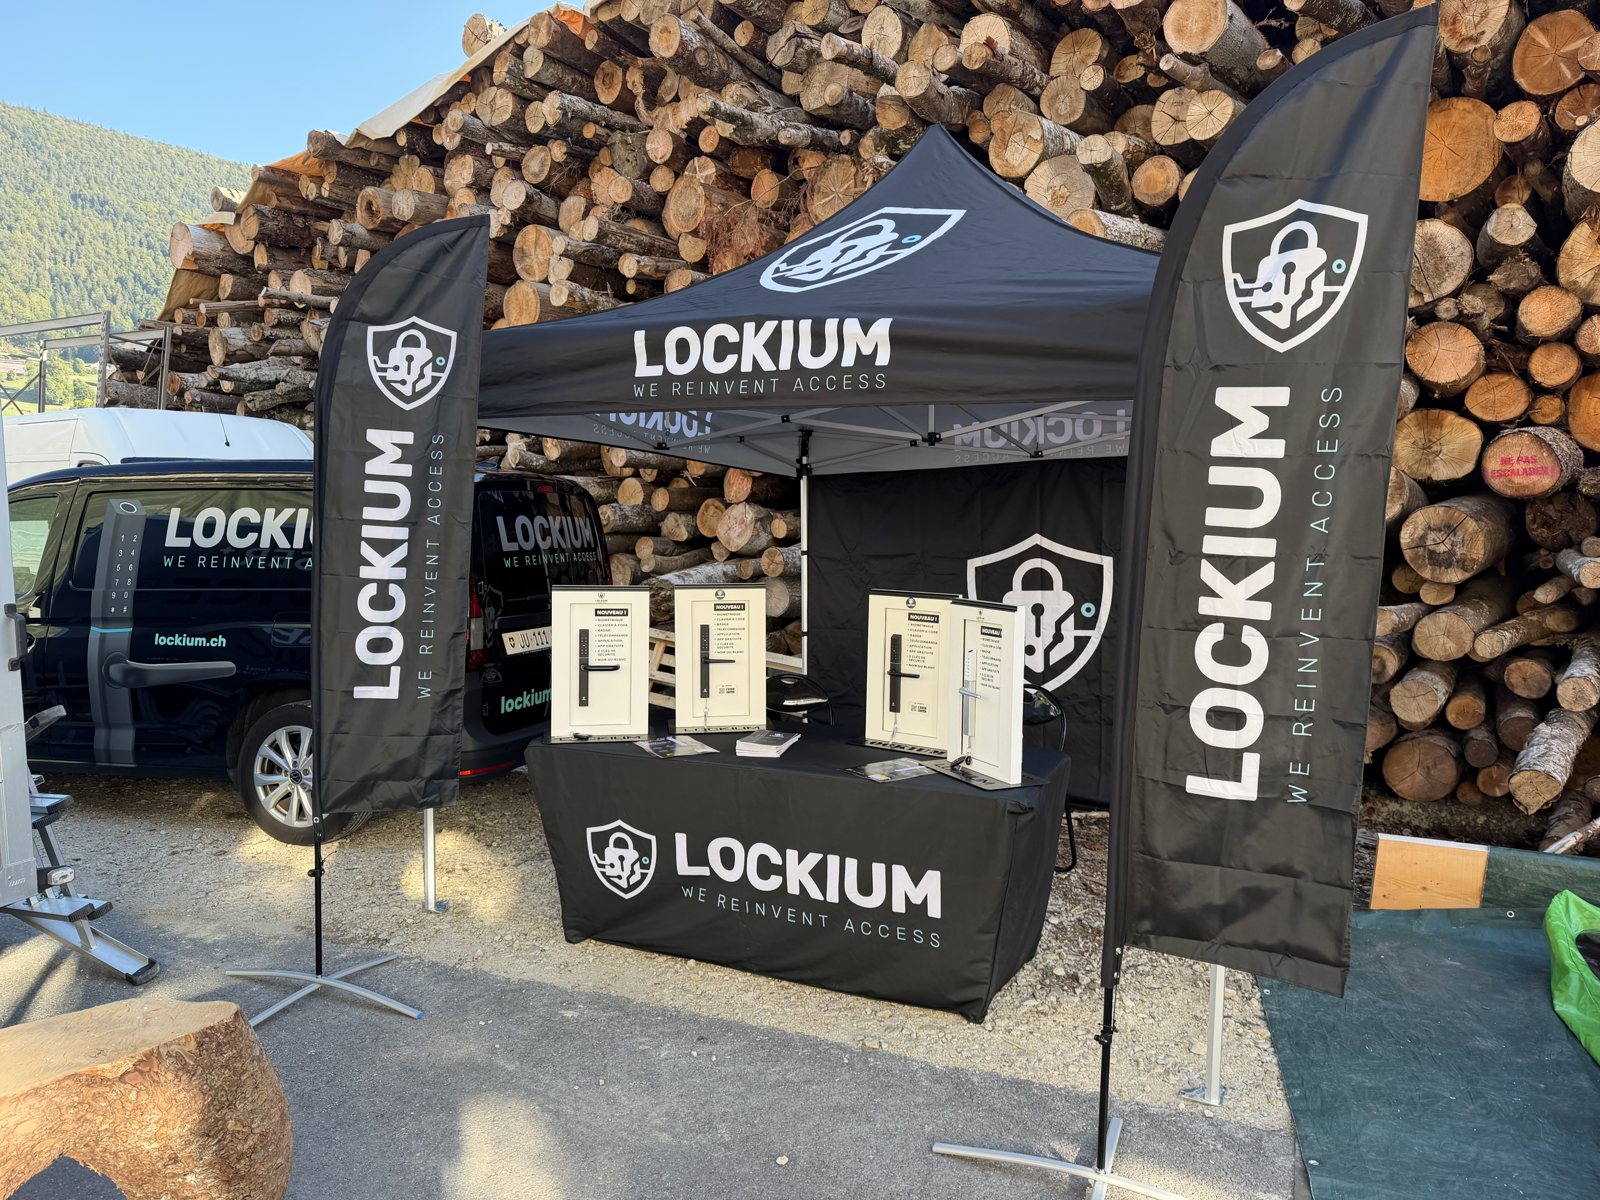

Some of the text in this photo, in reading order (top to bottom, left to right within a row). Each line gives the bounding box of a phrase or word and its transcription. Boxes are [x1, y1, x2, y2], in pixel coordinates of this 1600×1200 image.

[633, 318, 894, 378] LOCKIUM
[634, 374, 886, 398] WE REINVENT ACCESS
[164, 507, 314, 549] LOCKI
[496, 515, 595, 552] LOCKIUM
[164, 556, 186, 568] WE
[198, 556, 294, 570] REINVENT
[353, 428, 414, 700] LOCKIUM
[418, 434, 444, 699] WE REINVENT ACCESS
[504, 552, 598, 568] WE REINVENT ACCESS
[1185, 386, 1291, 802] LOCKIUM
[1286, 386, 1342, 805] WE REINVENT ACCESS
[154, 633, 226, 648] lockium.ch
[674, 832, 942, 919] LOCKIUM
[681, 886, 941, 948] WE REINVENT ACCESS
